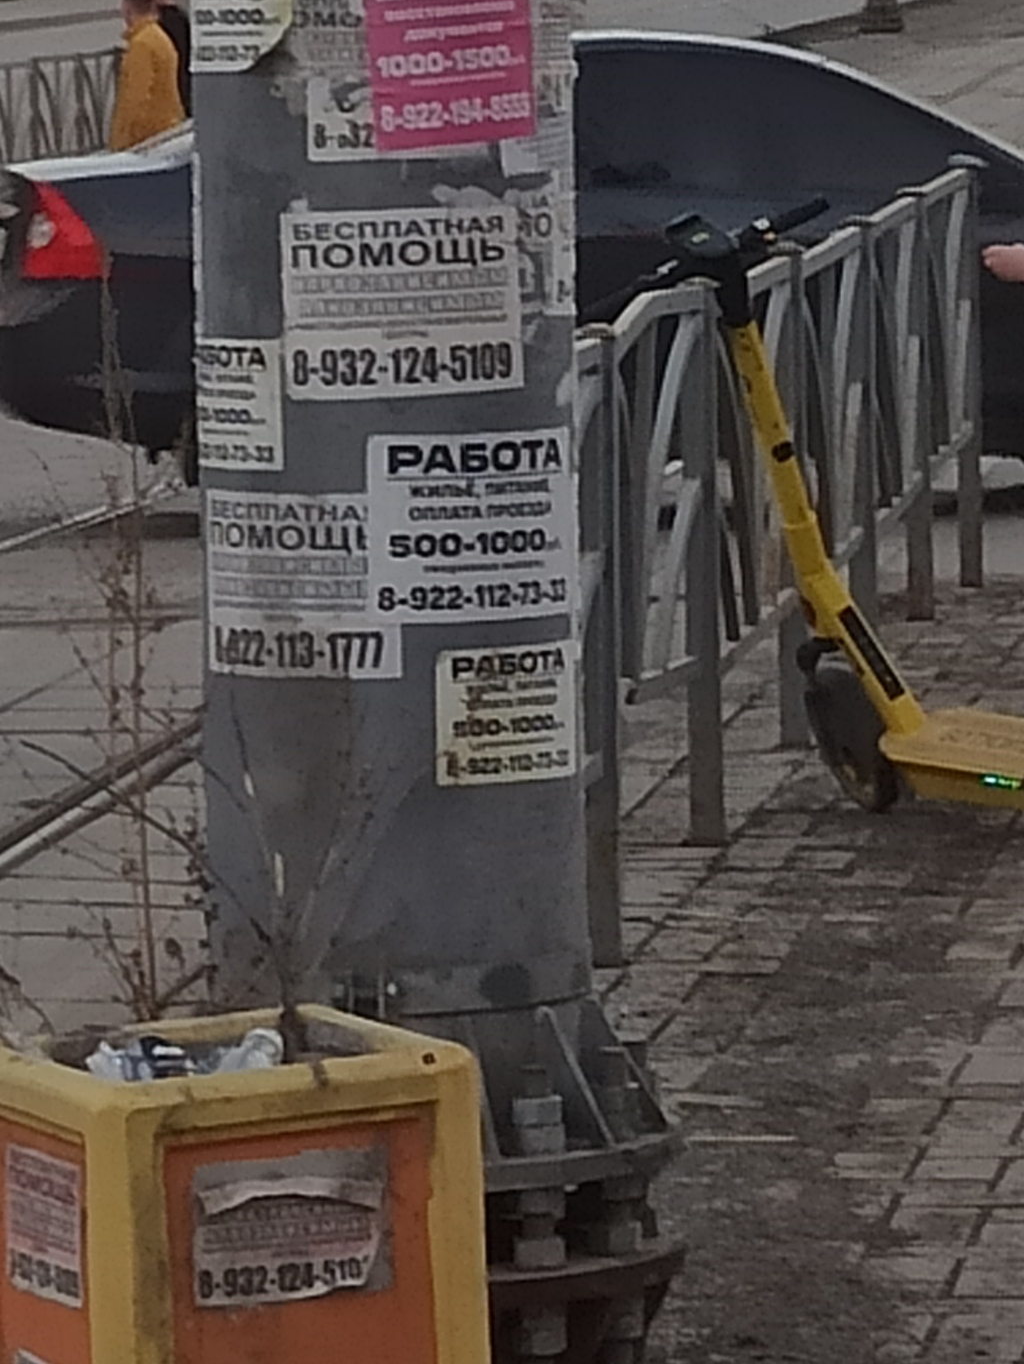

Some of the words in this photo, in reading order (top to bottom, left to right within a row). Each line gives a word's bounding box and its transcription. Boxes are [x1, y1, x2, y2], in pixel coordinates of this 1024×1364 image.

[377, 45, 511, 78] 1000-1500
[292, 216, 504, 242] БЕСПЛАТНАЯ
[291, 238, 505, 269] ПОМОЩЬ
[293, 341, 513, 387] 8-932-124-5109
[387, 438, 561, 475] РАБОТА
[211, 501, 368, 522] БЕСПЛАТНА
[409, 505, 482, 521] ОПЛАТА
[389, 529, 546, 558] 500-1000
[452, 648, 565, 680] РАБОТА
[198, 1255, 370, 1298] 8-932-124-510
